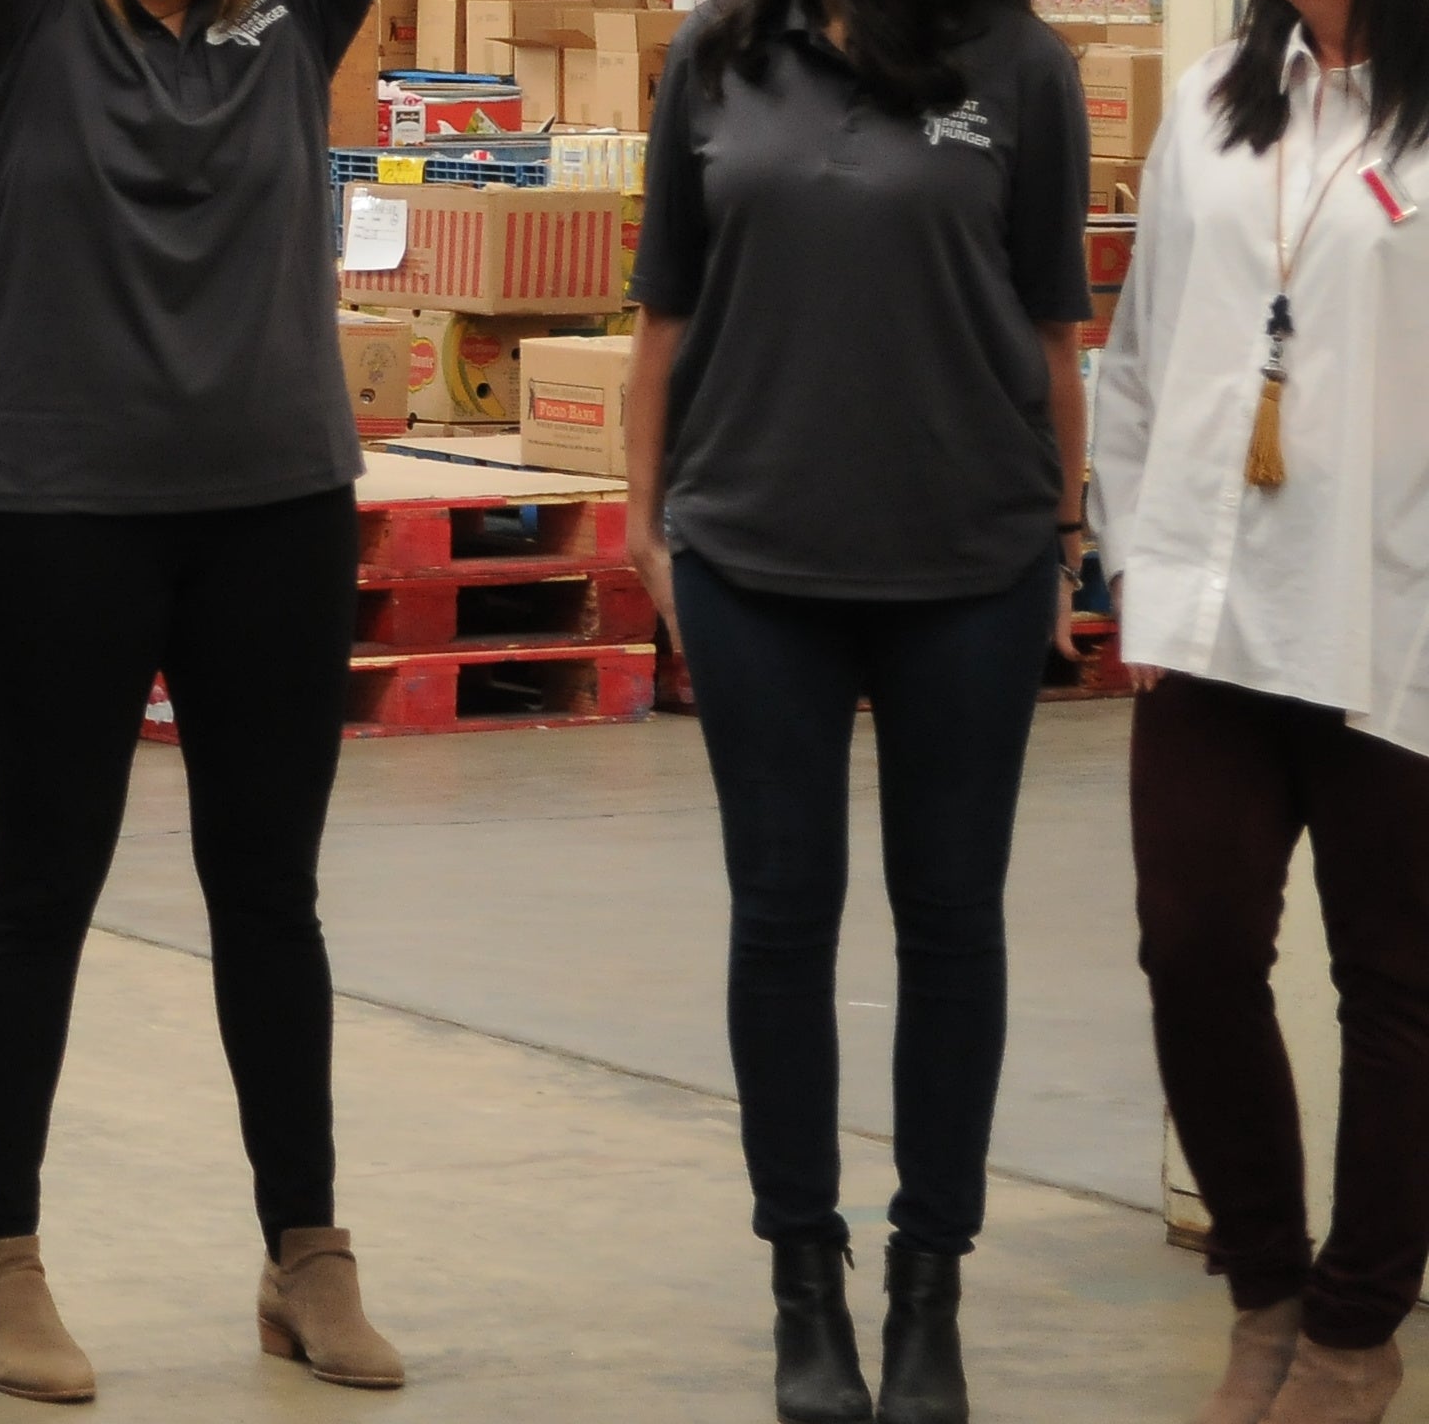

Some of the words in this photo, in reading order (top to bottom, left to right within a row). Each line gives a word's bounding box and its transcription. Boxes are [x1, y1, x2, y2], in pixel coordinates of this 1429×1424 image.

[248, 5, 289, 37] HUNGER
[952, 110, 988, 125] uburn
[940, 127, 992, 148] HUNGER
